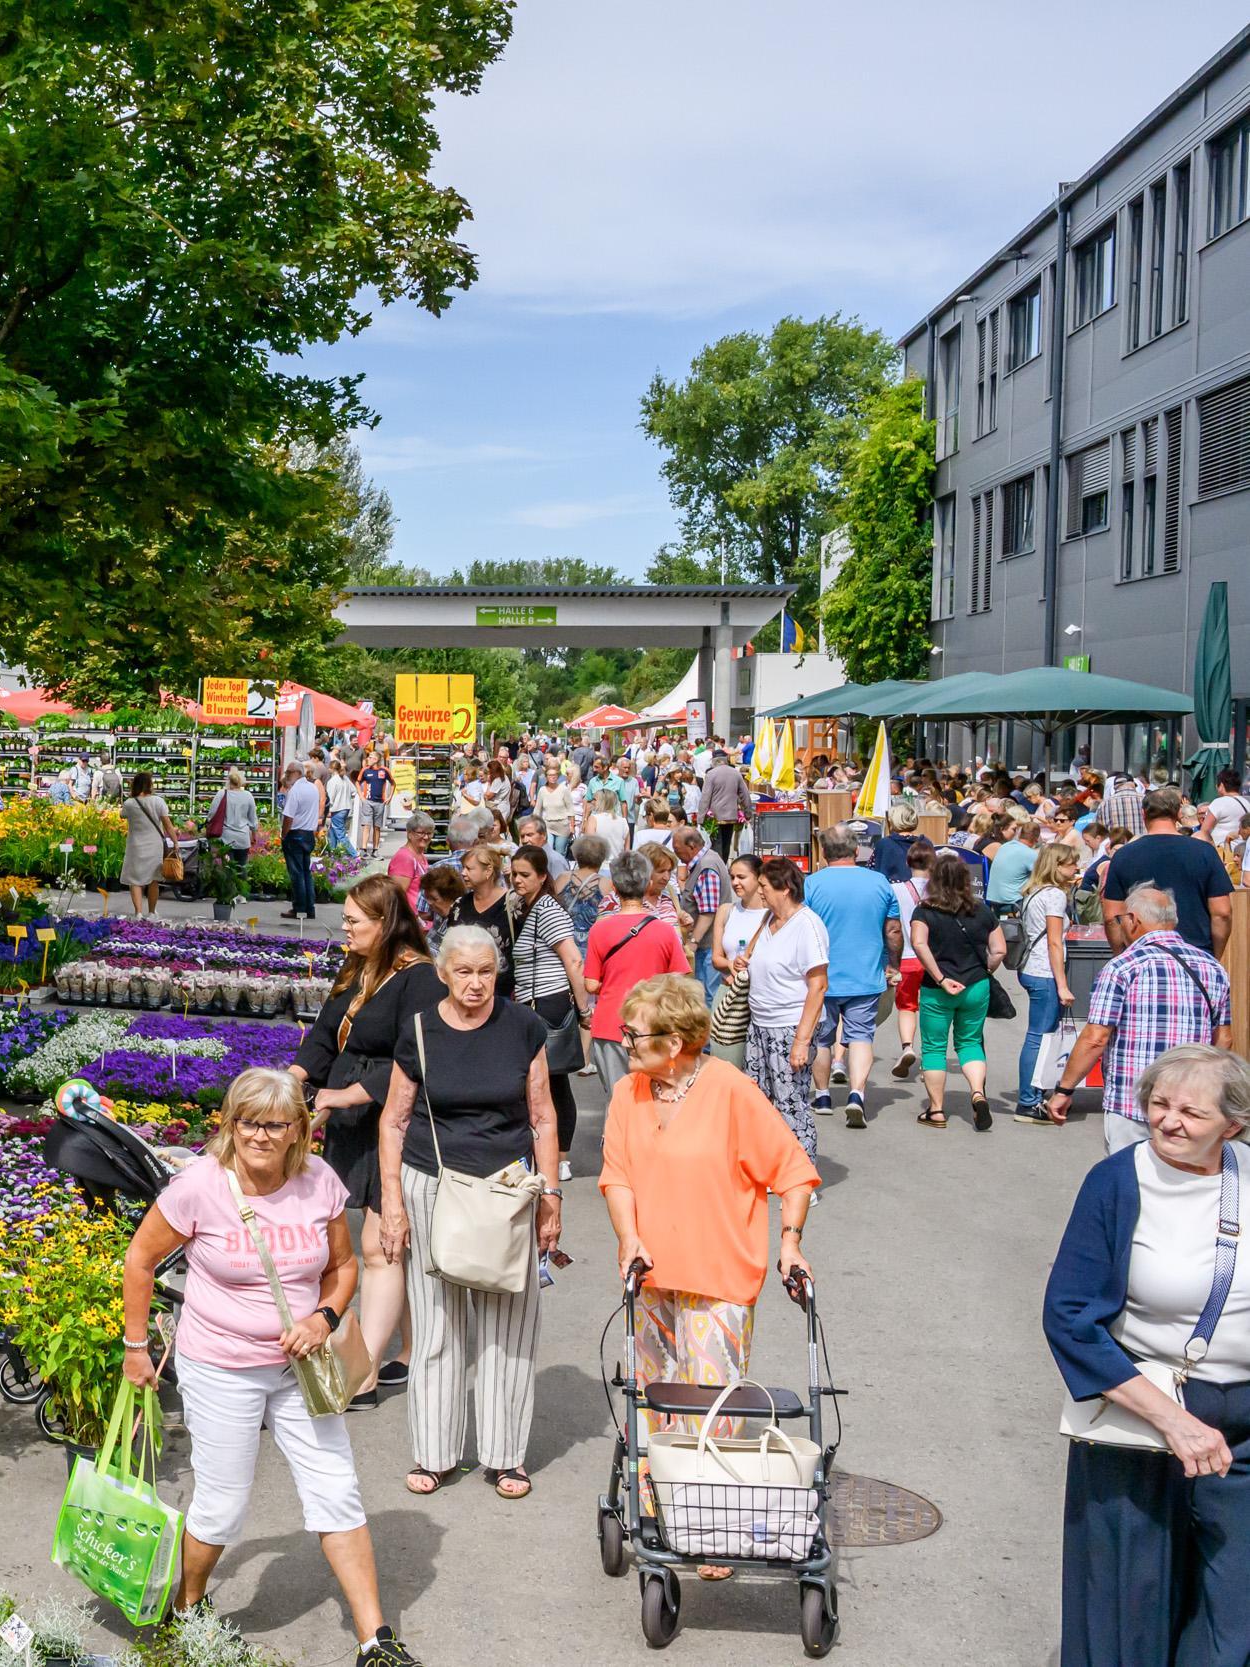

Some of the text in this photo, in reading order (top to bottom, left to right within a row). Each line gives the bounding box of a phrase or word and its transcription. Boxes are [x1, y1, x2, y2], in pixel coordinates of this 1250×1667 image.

[498, 607, 535, 615] HALLE 6
[498, 617, 526, 625] HALLE
[206, 680, 245, 692] Jeder Topf
[206, 691, 248, 703] Winterfeste
[206, 704, 247, 715] Blumen
[398, 705, 451, 723] Gewürze
[398, 723, 446, 742] Kräuter
[225, 1223, 323, 1255] BLOOM
